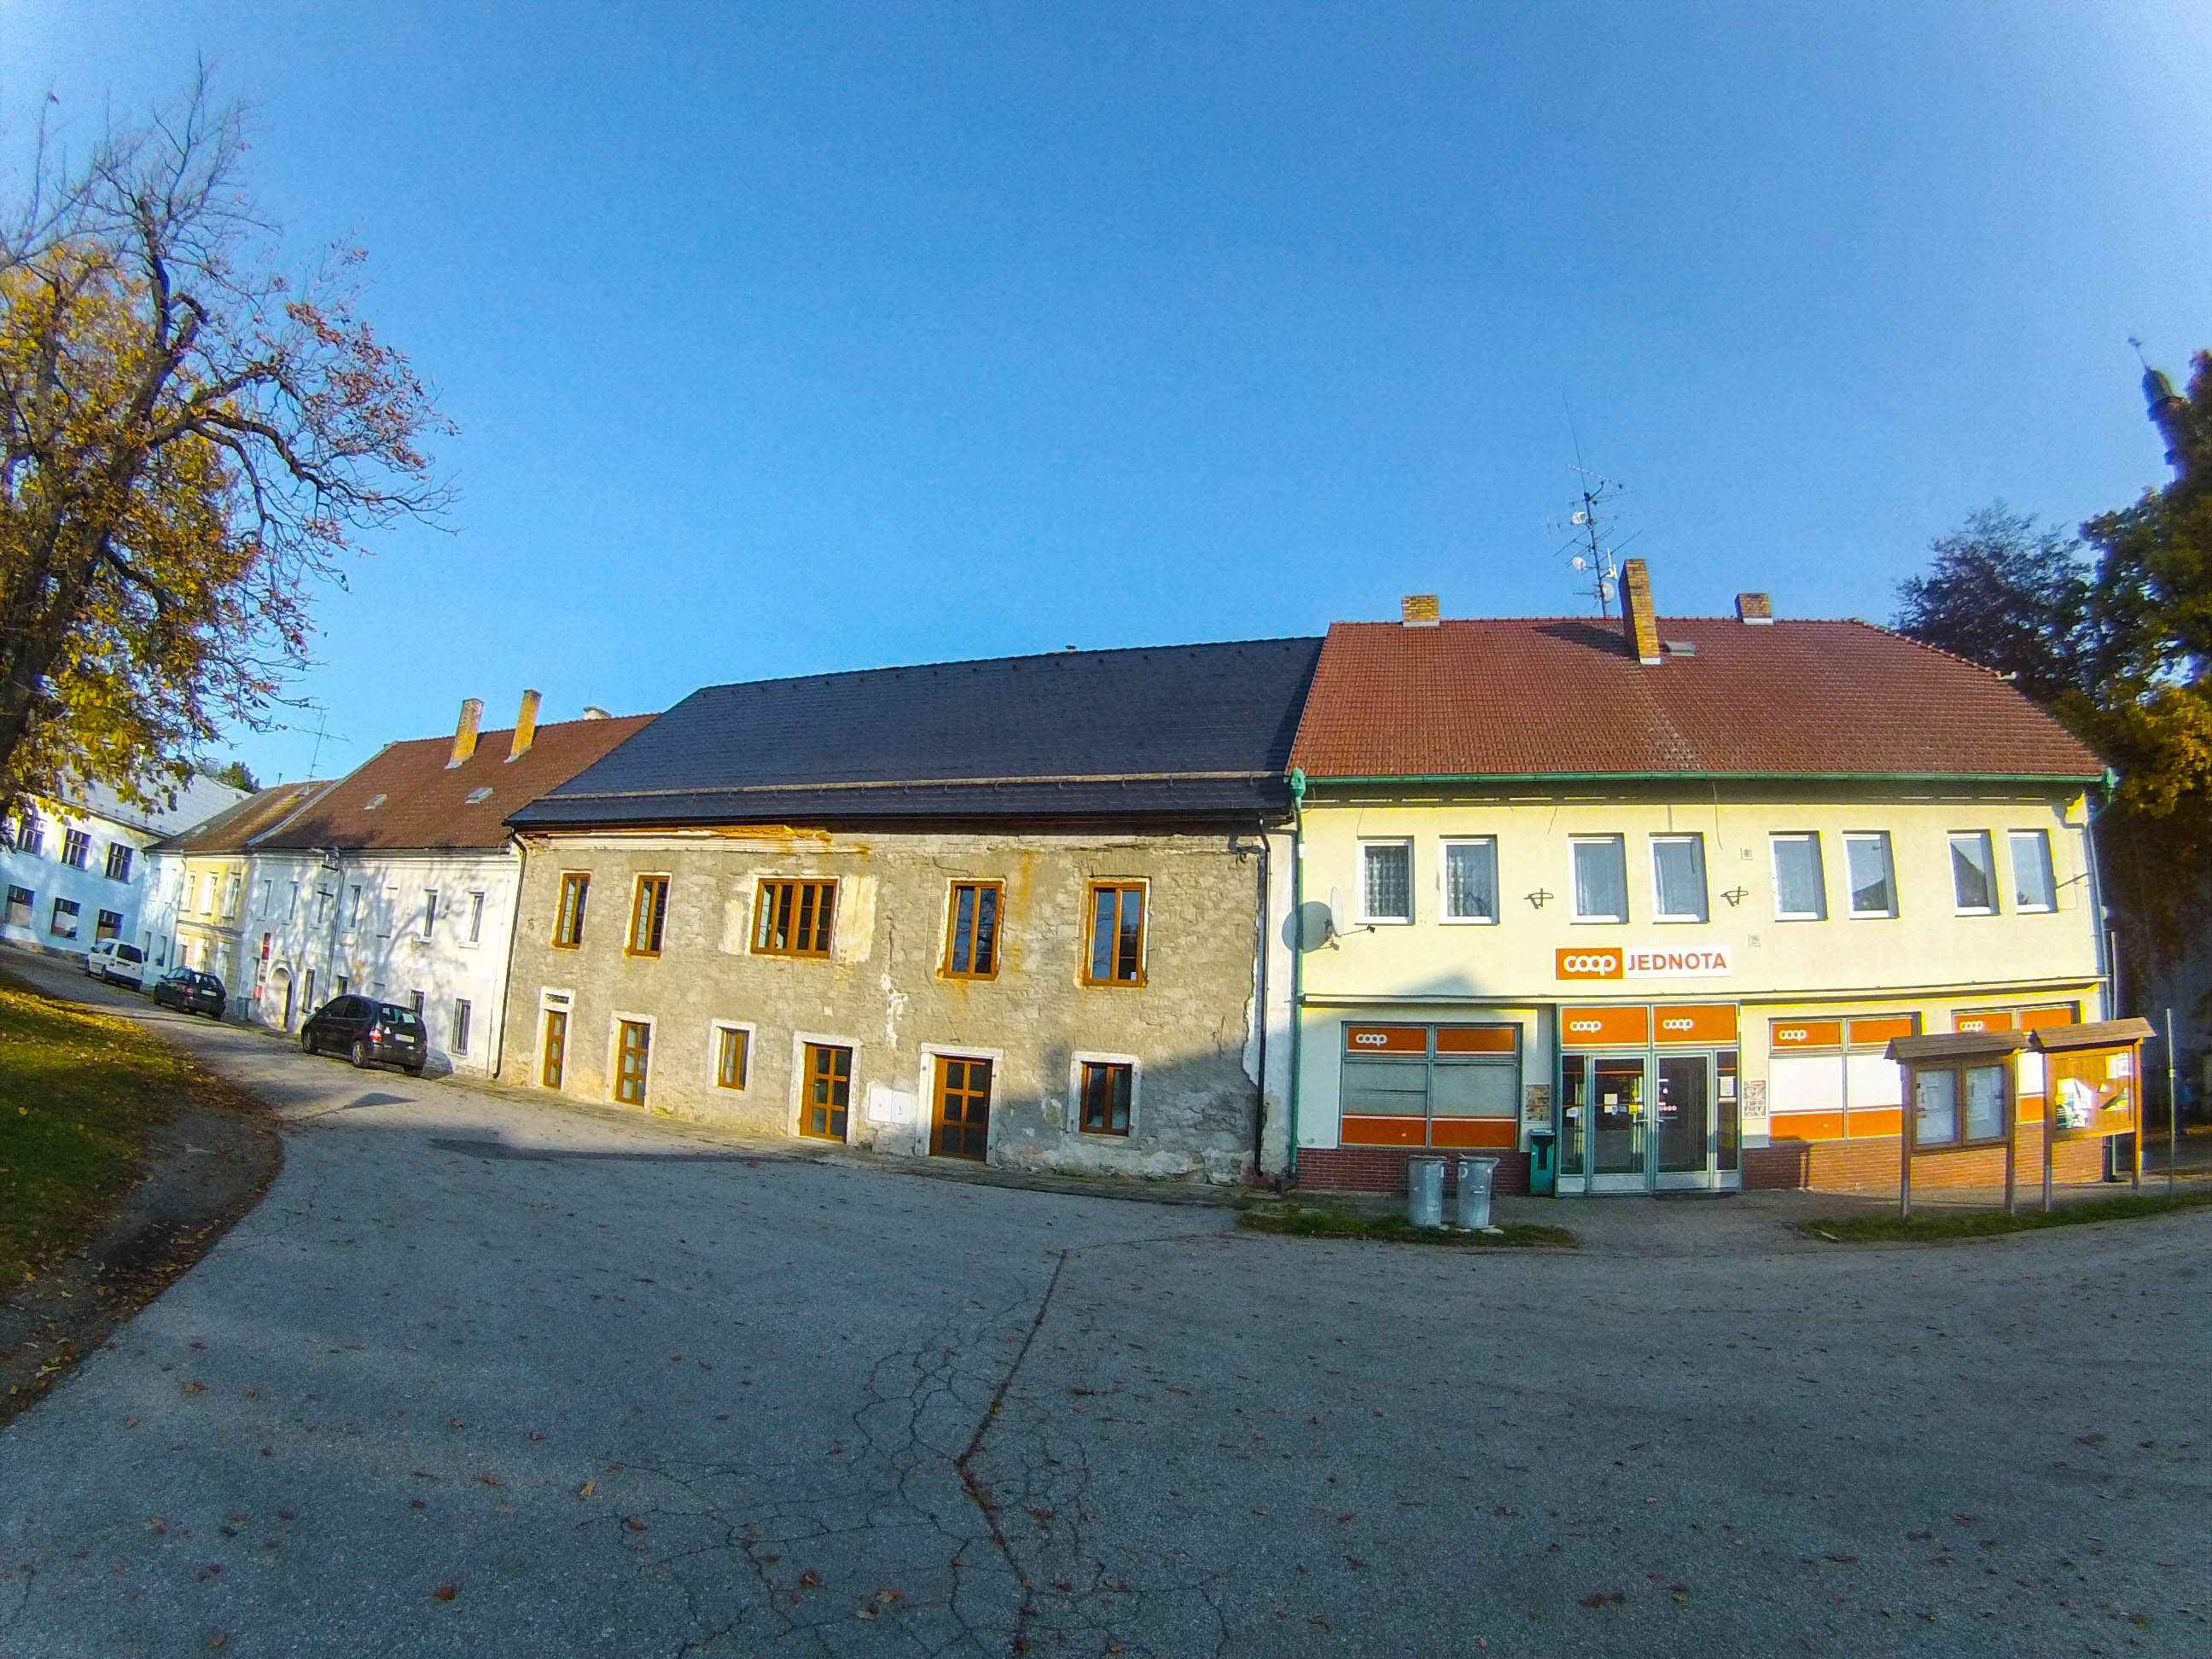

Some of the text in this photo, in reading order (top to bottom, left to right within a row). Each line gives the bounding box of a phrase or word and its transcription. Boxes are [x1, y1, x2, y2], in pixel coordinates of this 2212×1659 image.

[1563, 953, 1727, 975] coop JEDNOTA
[1569, 1021, 1601, 1033] coop
[1662, 1018, 1693, 1031] coop
[1356, 1033, 1387, 1046] coop
